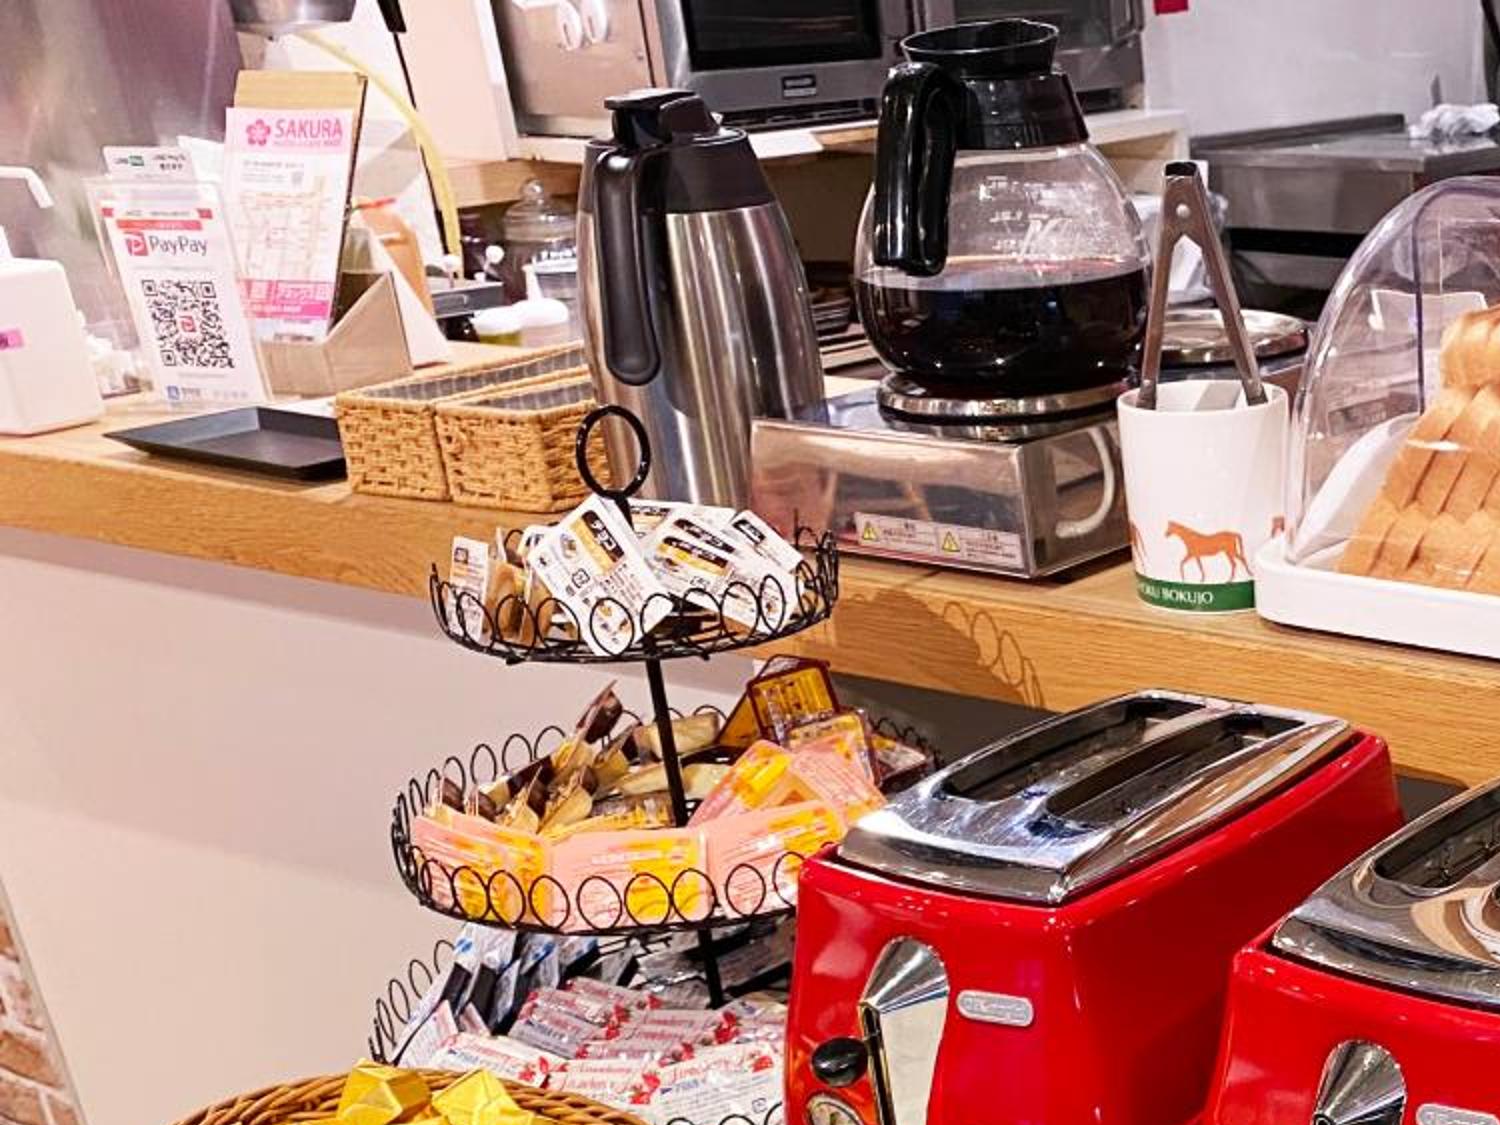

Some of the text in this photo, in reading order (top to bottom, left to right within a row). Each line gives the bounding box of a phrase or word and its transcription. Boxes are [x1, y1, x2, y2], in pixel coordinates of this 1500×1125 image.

[274, 118, 344, 139] SAKURA
[149, 235, 208, 257] PayPay
[1162, 587, 1214, 604] BOKUJO
